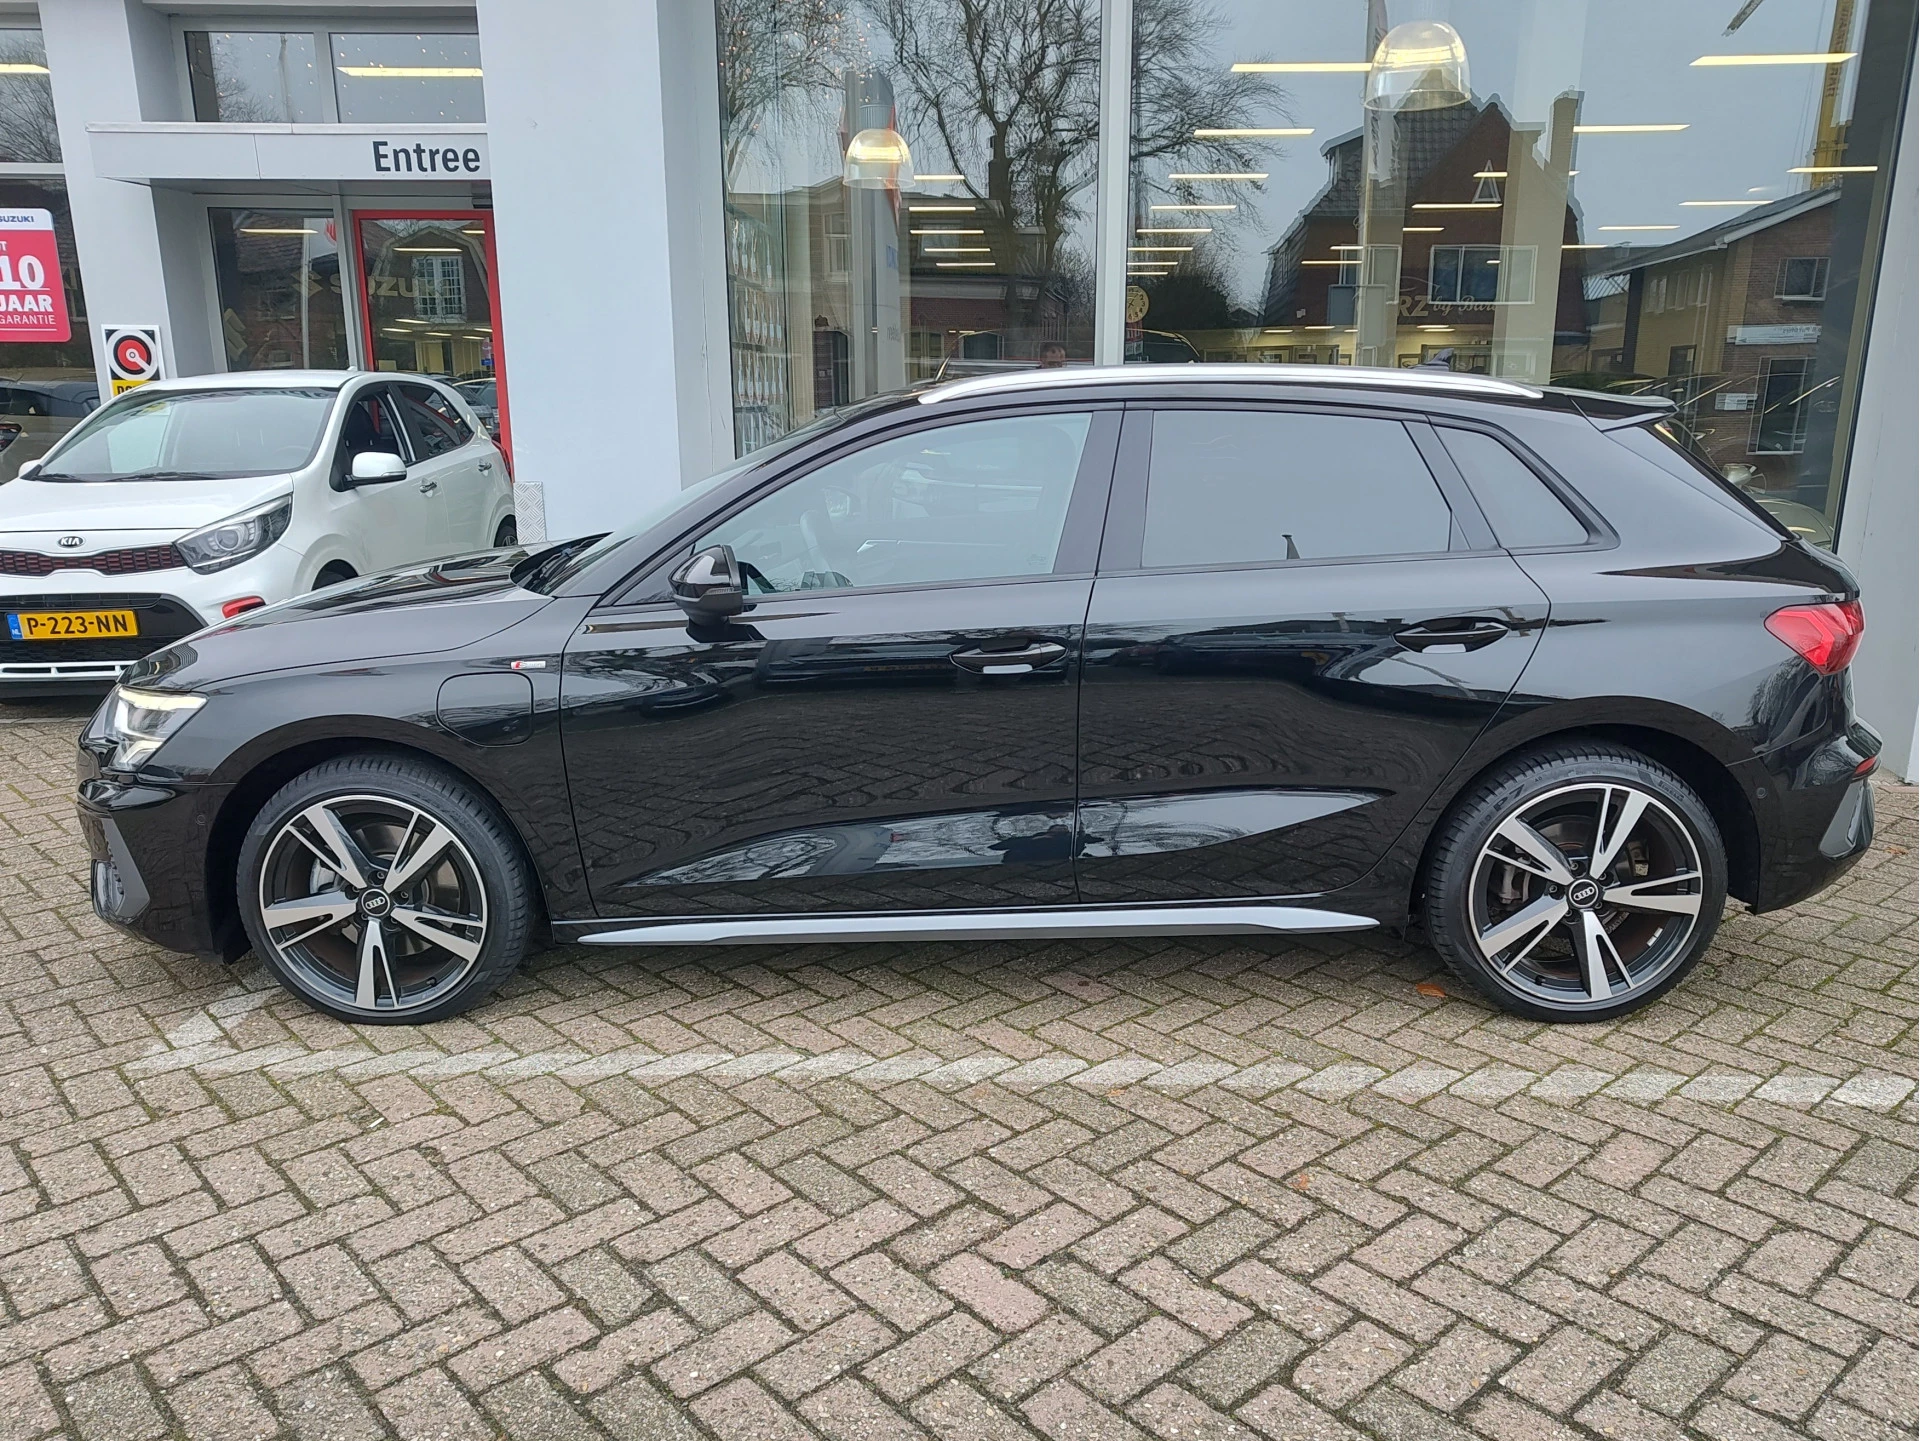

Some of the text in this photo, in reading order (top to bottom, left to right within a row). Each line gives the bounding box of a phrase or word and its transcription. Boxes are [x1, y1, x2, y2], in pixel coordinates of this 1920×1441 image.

[372, 140, 481, 173] Entree
[0, 254, 45, 289] 10
[0, 314, 56, 325] GARANTIE
[60, 537, 80, 546] KIA
[26, 614, 128, 635] P-223-NN
